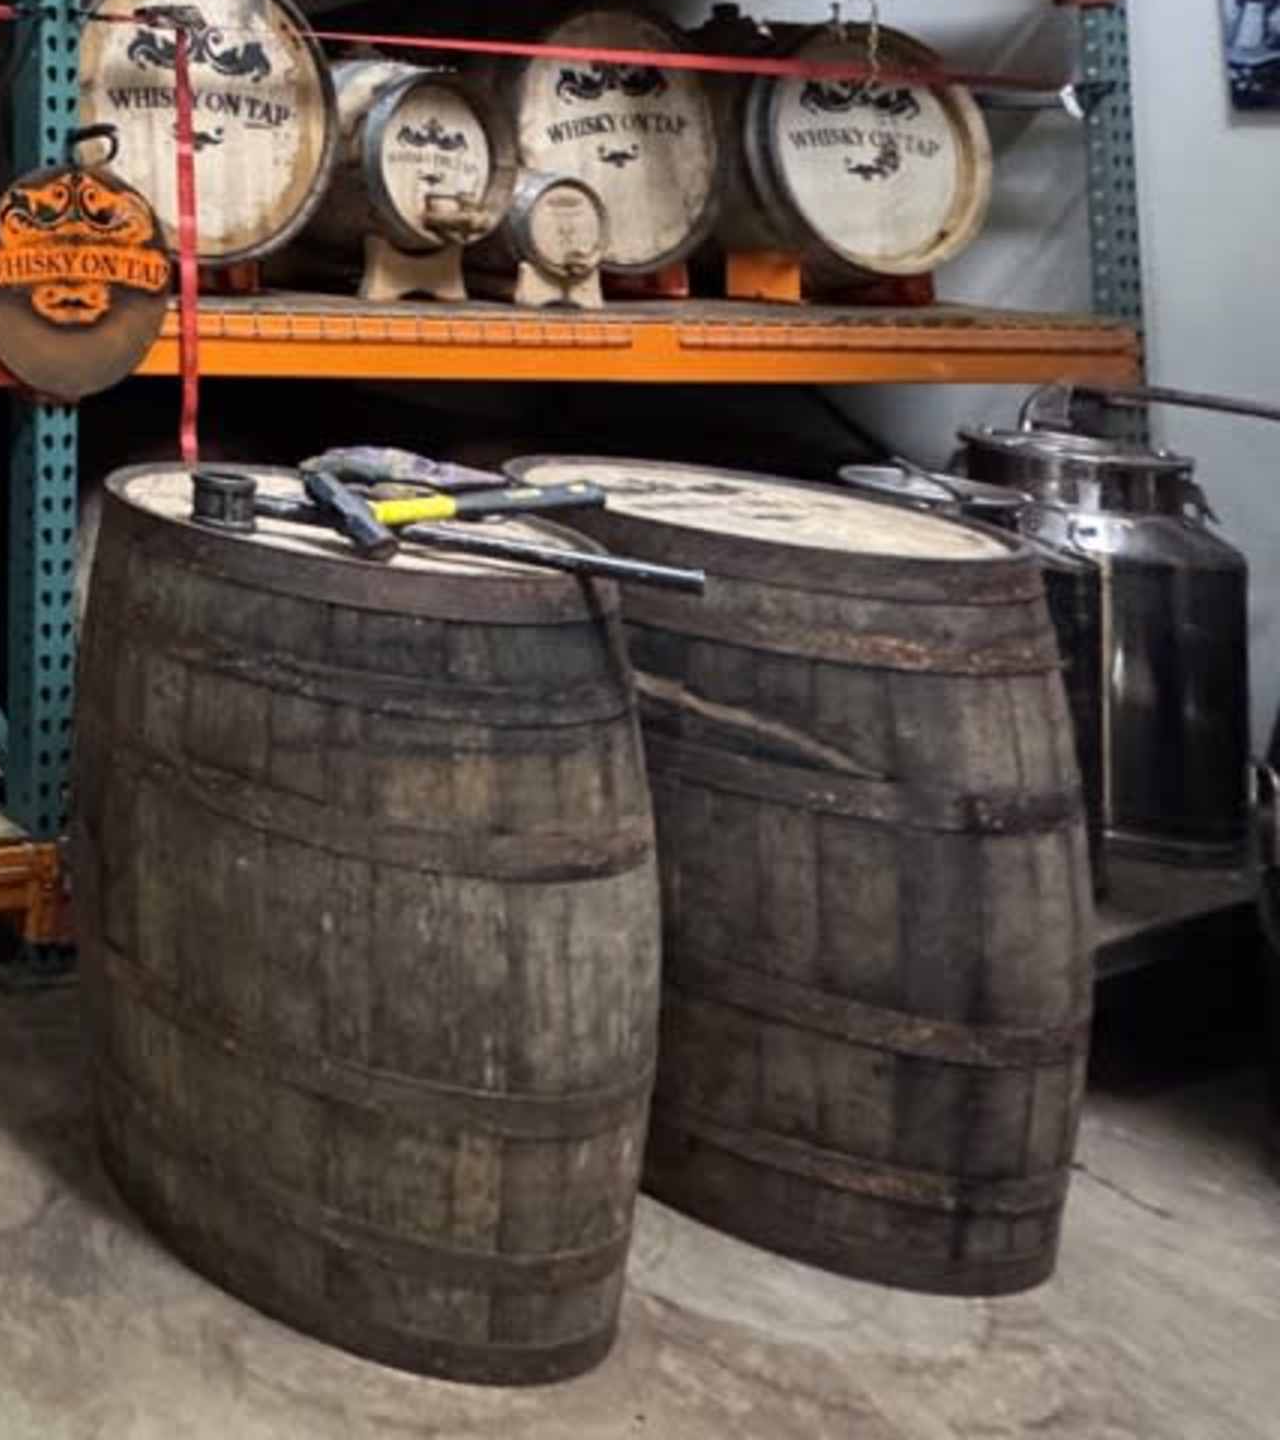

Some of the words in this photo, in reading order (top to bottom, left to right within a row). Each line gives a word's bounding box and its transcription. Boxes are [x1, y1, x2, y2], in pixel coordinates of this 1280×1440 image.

[107, 86, 202, 109] WHISY
[205, 91, 240, 117] ON
[244, 96, 290, 127] TAP
[545, 113, 616, 143] WHISKY
[788, 127, 864, 150] WHISKY
[896, 132, 941, 157] TAP
[81, 253, 118, 277] ON
